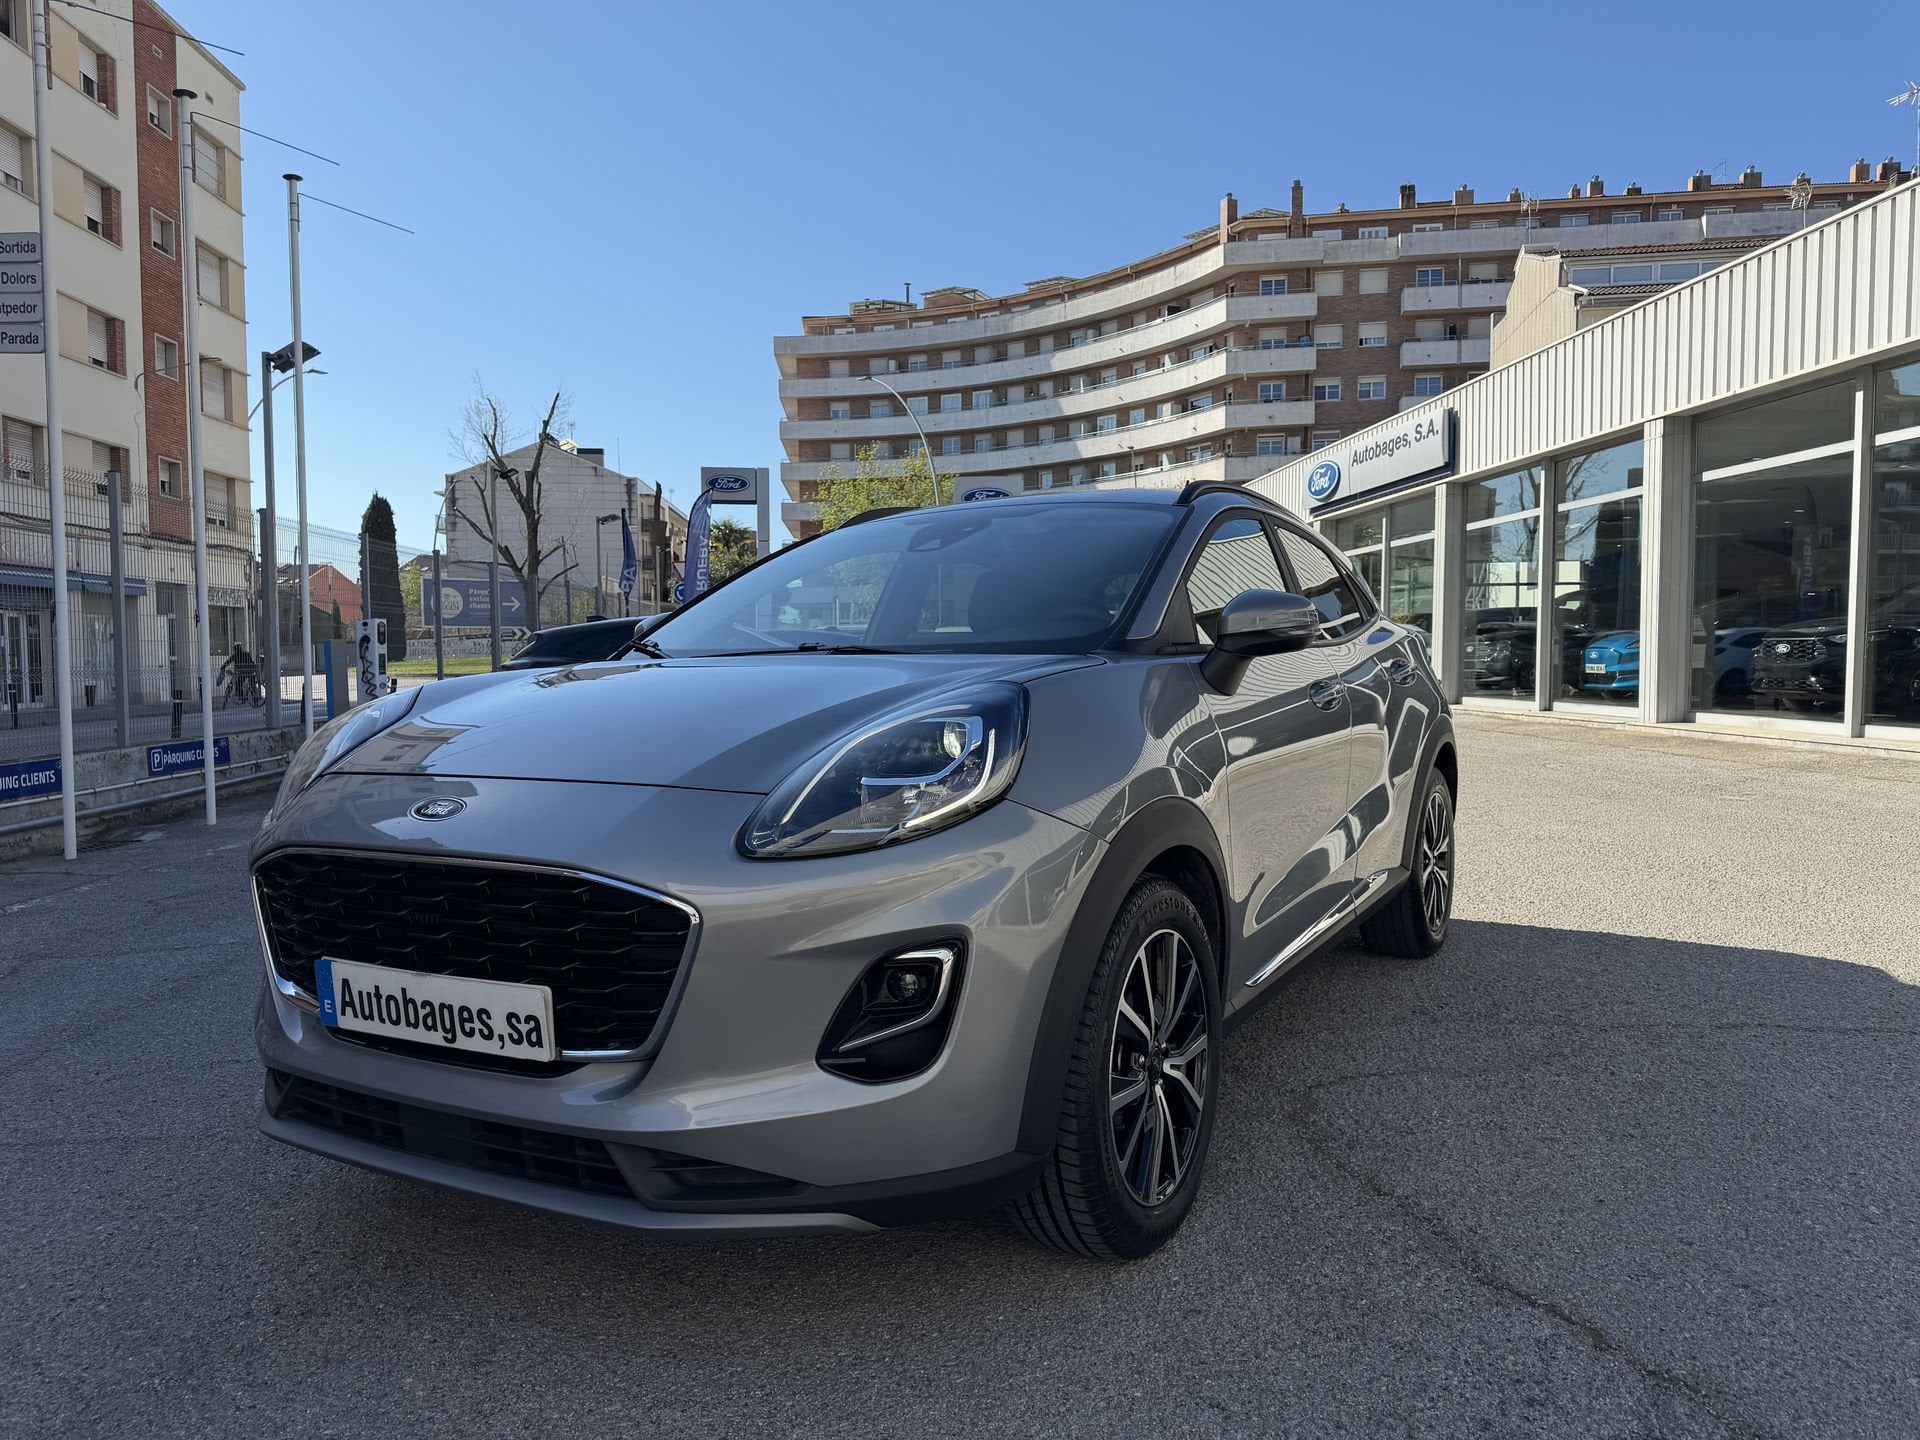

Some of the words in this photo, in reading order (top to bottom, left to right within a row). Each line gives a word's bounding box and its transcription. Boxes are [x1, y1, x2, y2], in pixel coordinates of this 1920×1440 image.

[1, 272, 37, 285] Dolors
[0, 302, 38, 317] tpedor
[0, 332, 39, 345] Parada
[1351, 433, 1411, 467] Autobages,
[1414, 418, 1439, 443] S.A.
[715, 477, 742, 489] Ford
[1311, 468, 1331, 491] Ford
[163, 750, 196, 765] PÀRQUING
[20, 770, 56, 788] CLIENTS
[324, 1000, 333, 1013] E
[340, 978, 544, 1050] Autobages,sa
